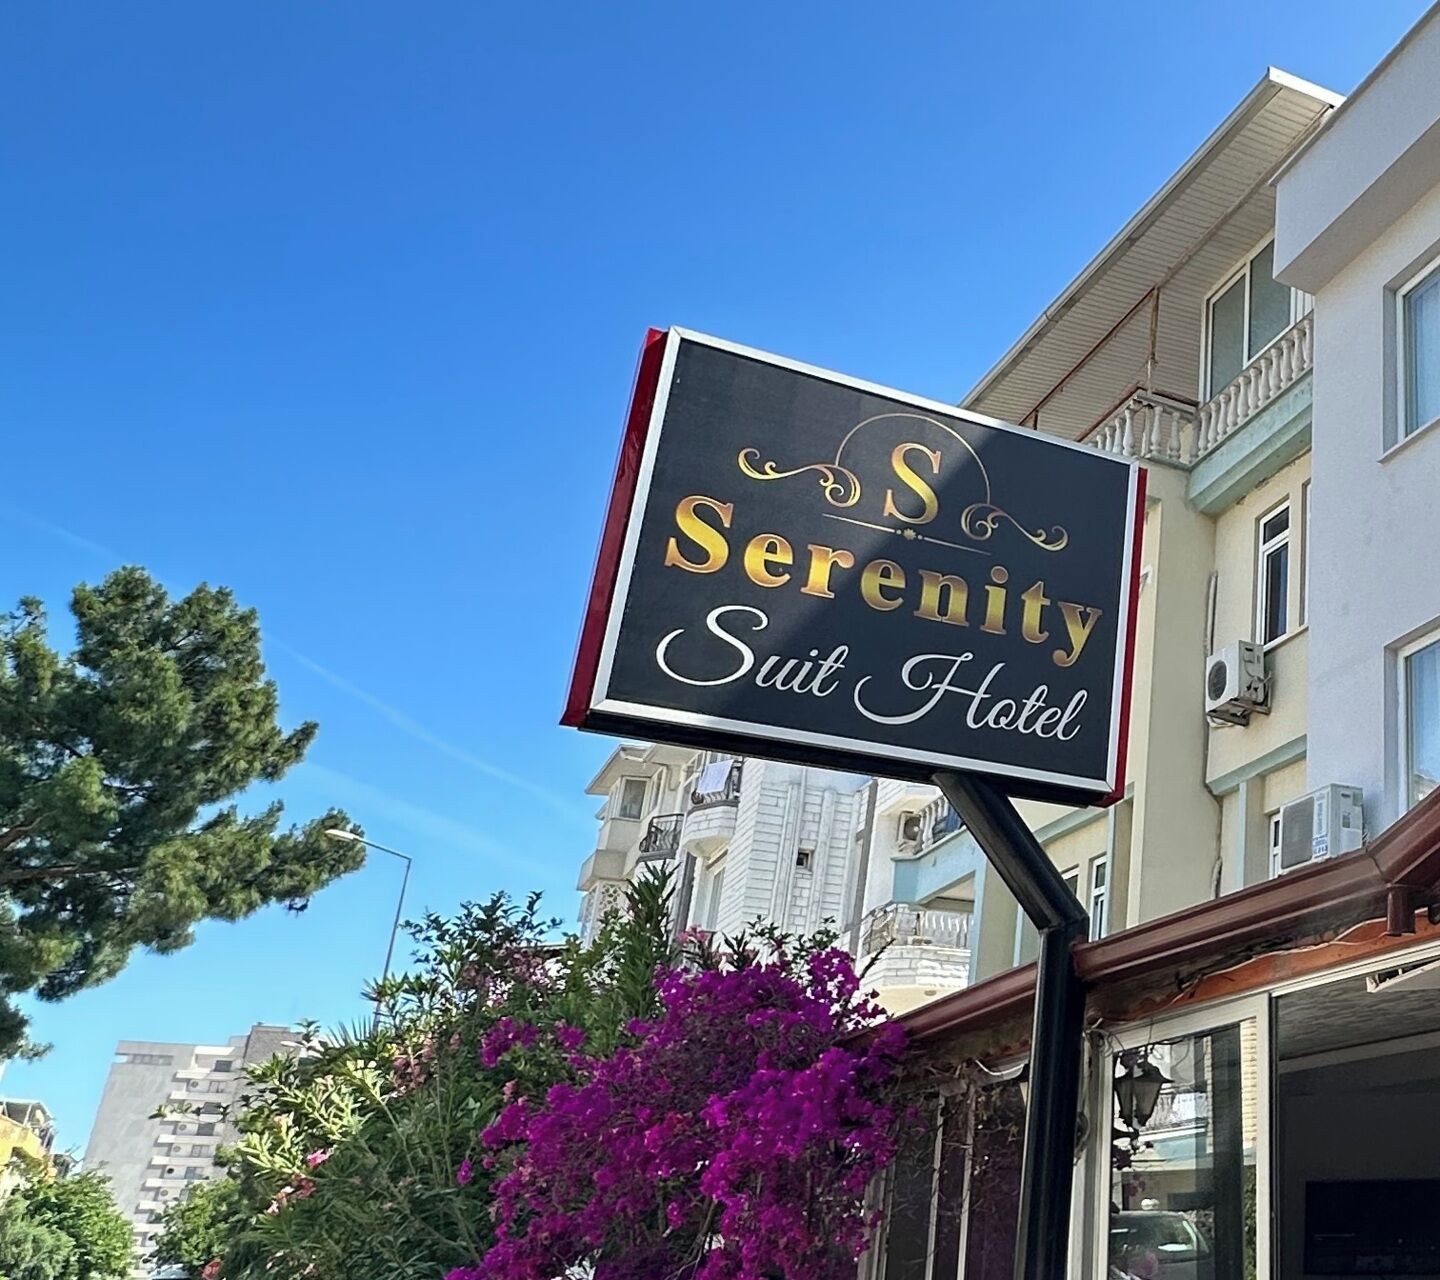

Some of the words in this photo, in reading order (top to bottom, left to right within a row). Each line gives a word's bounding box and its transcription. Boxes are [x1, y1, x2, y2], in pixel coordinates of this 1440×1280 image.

[883, 443, 942, 524] S
[664, 495, 1102, 667] Serenity
[655, 605, 849, 698] Suit
[853, 652, 1089, 741] Hotel
